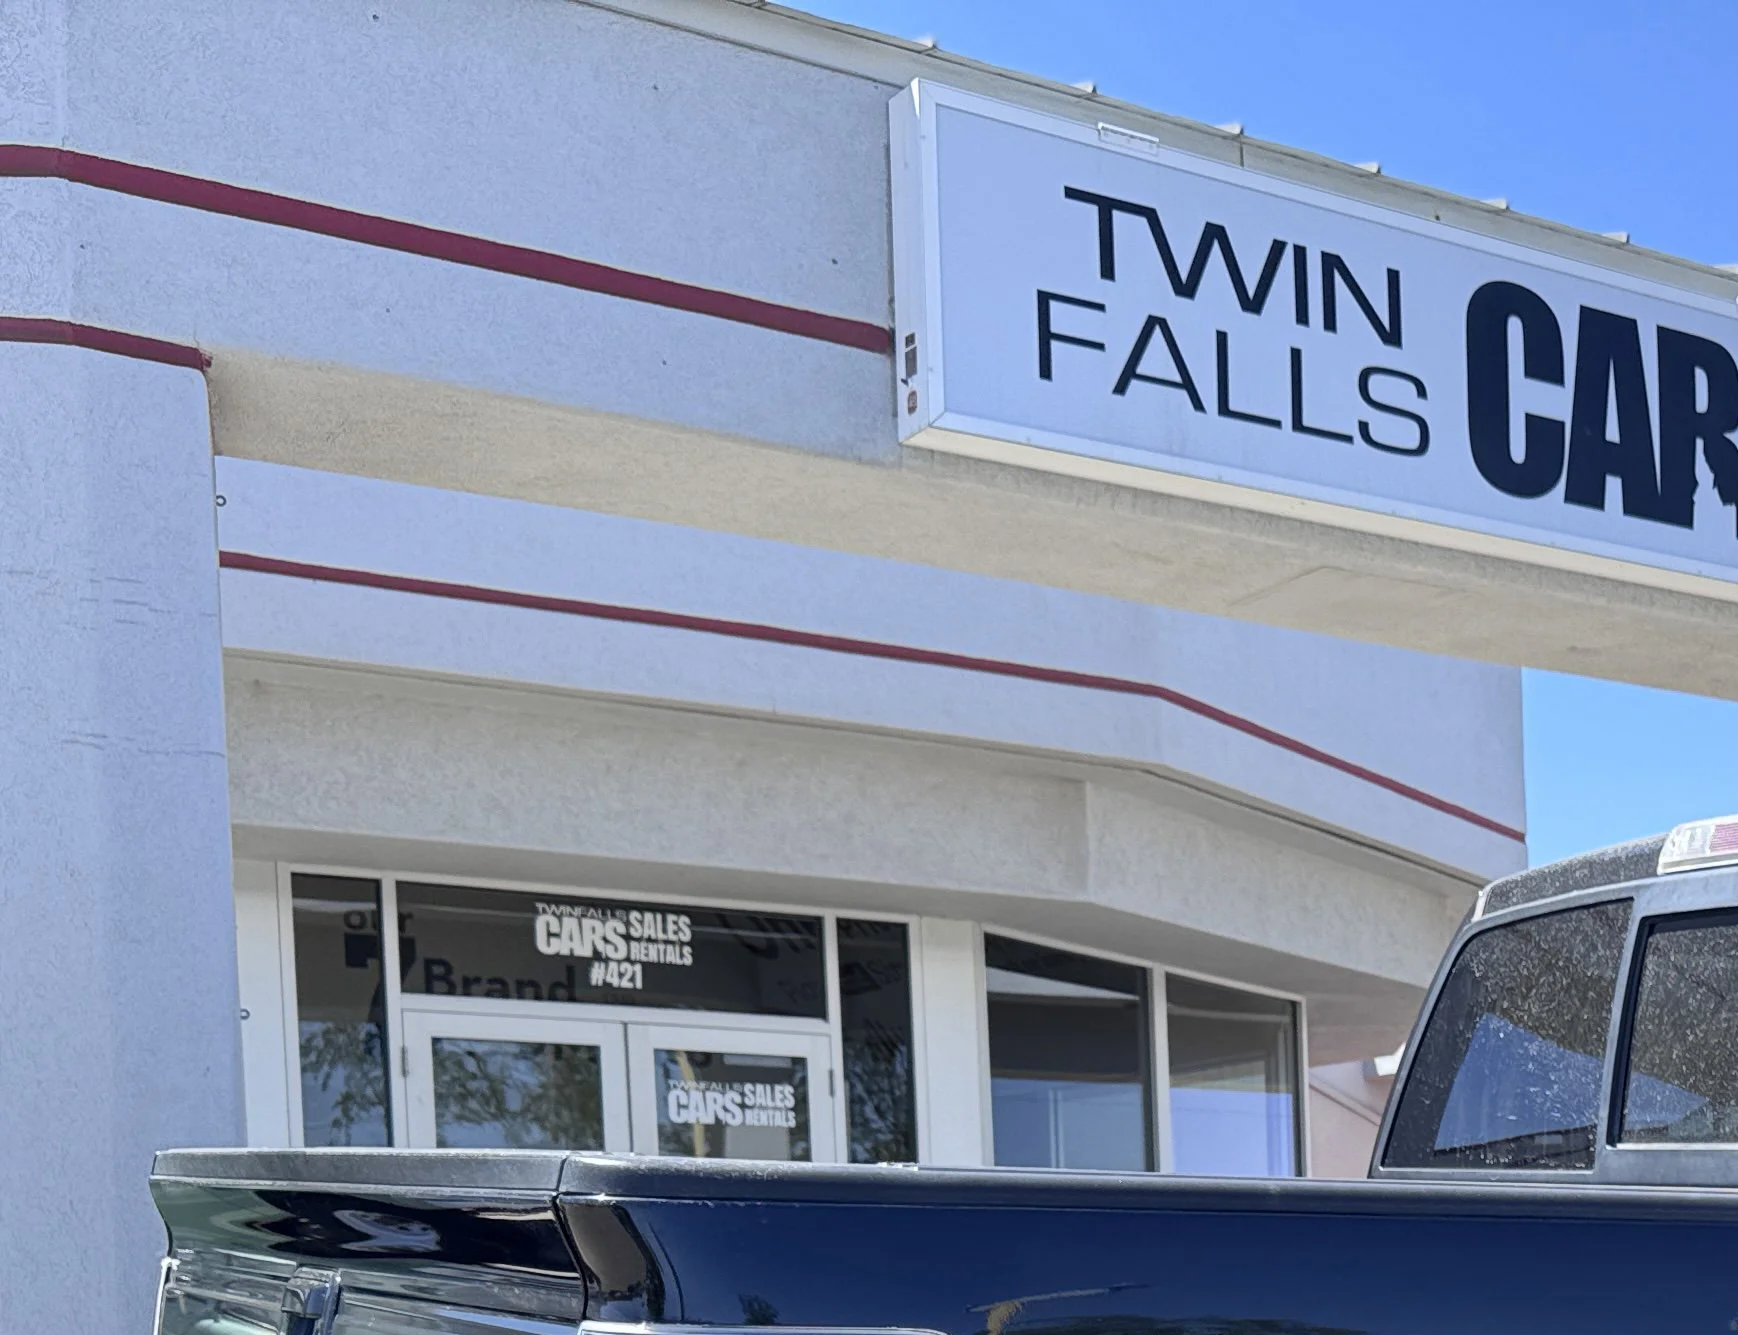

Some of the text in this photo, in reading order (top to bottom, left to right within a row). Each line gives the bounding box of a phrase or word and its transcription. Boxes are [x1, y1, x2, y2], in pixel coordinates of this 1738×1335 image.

[1064, 185, 1401, 348] TWIN
[1037, 289, 1430, 456] FALLS
[536, 914, 628, 960] CARS
[629, 910, 692, 942] SALES
[630, 940, 693, 966] RENTALS
[590, 961, 643, 989] #421
[668, 1090, 744, 1126] CARS
[744, 1082, 795, 1109] SALES
